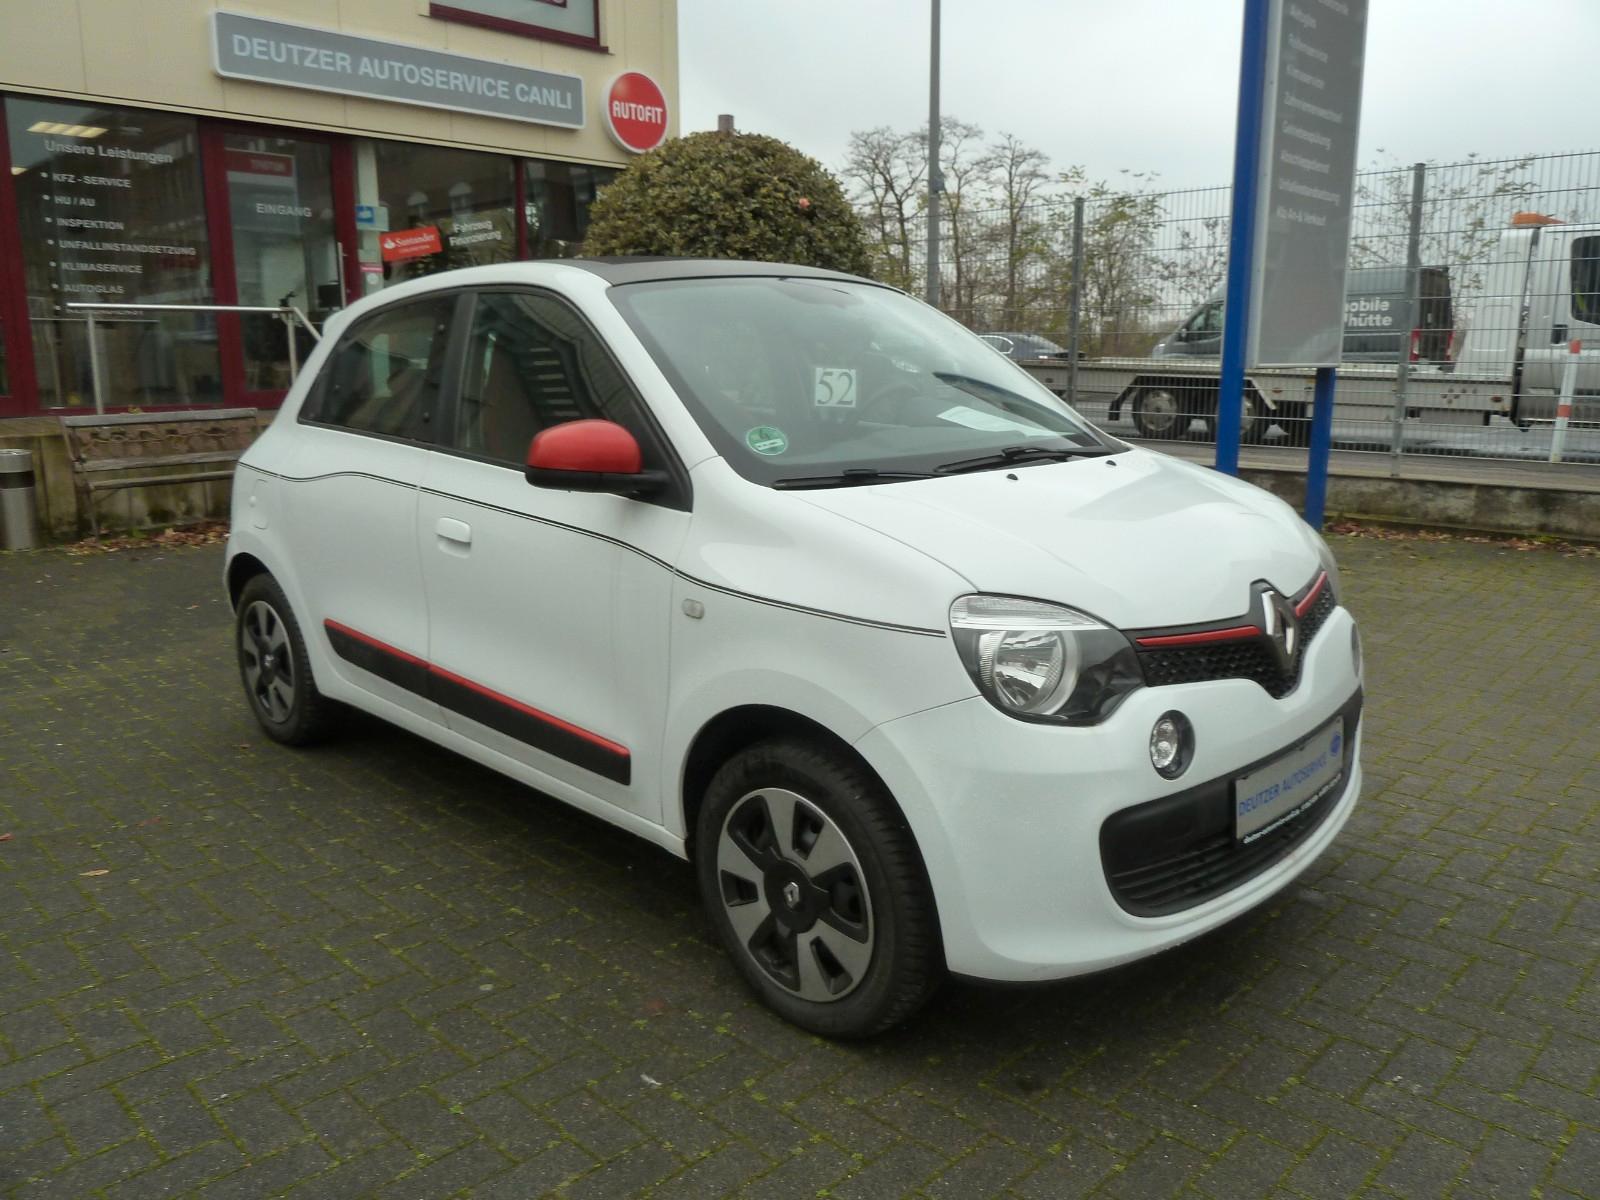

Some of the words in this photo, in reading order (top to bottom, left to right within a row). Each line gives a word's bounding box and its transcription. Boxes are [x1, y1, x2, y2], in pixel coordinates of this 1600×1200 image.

[232, 34, 352, 74] DEUTZER
[358, 56, 510, 100] AUTOSERVICE
[515, 83, 572, 110] CANLI
[612, 99, 663, 125] AUTOFIT
[44, 139, 95, 156] Unsere
[98, 145, 174, 165] Leistungen
[52, 172, 76, 184] KFZ
[83, 175, 132, 188] SERVICE
[256, 202, 312, 218] EINGANG
[56, 217, 125, 231] INSPEKTION
[58, 239, 197, 256] UNFALLINSTANDSETZUNG
[396, 232, 436, 247] Santander
[61, 261, 144, 274] KLIMASERVICE
[63, 283, 125, 295] AUTOGLAS
[817, 371, 853, 404] 52
[1239, 784, 1279, 815] DEUTZER
[1283, 753, 1327, 789] AUTOSERVICE
